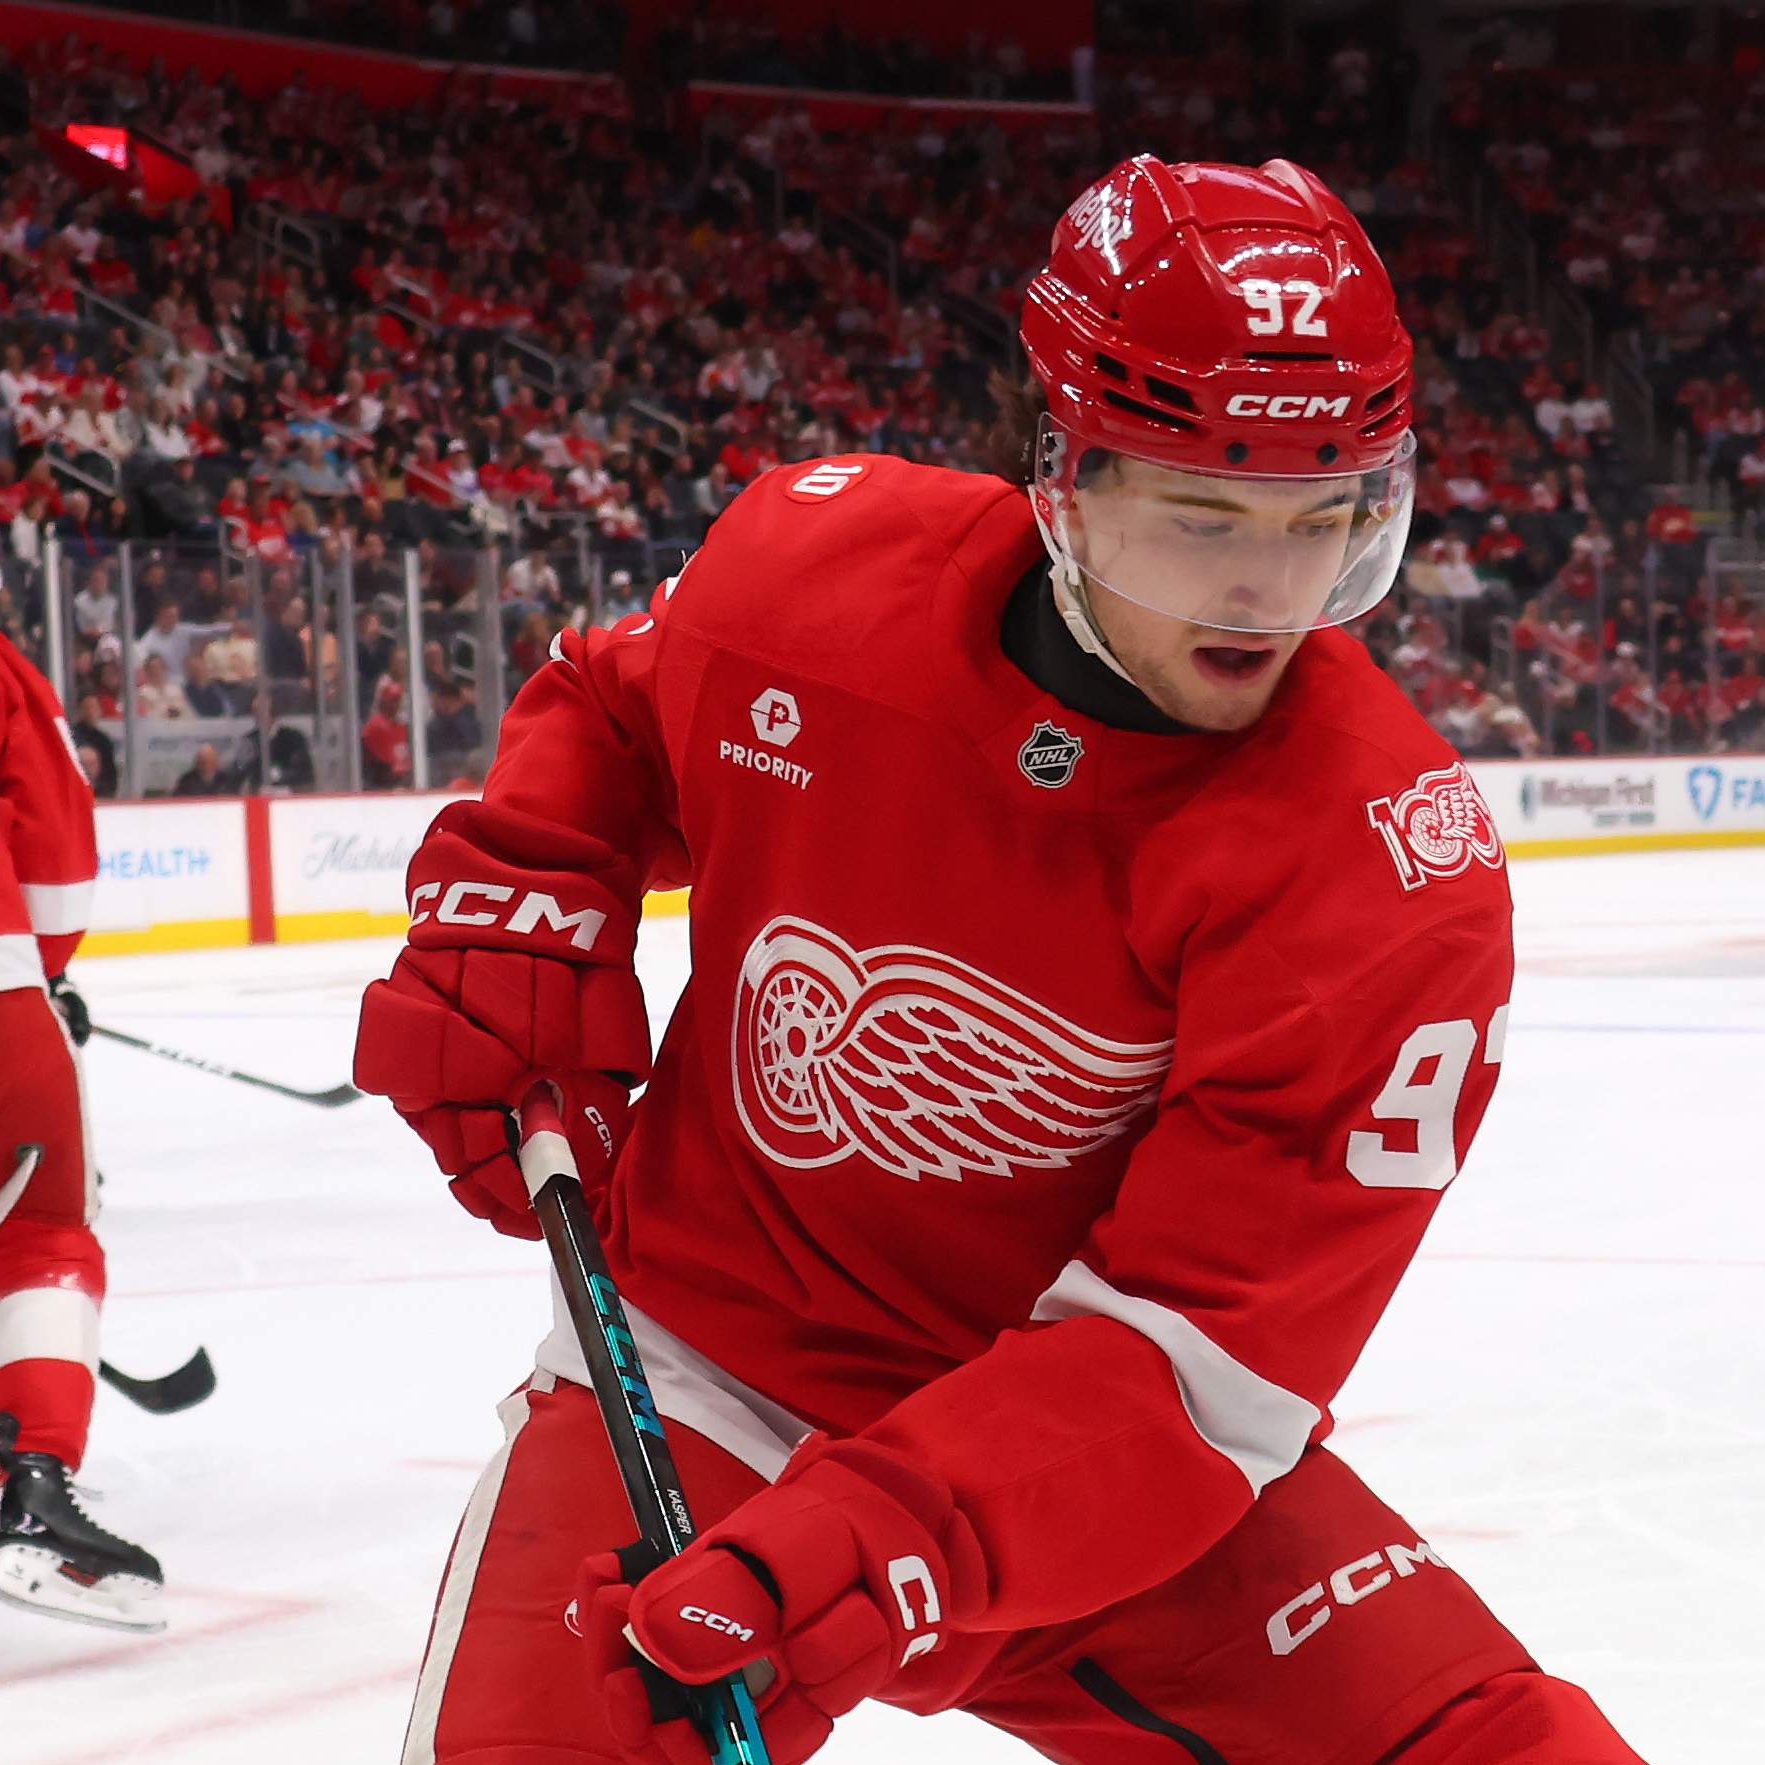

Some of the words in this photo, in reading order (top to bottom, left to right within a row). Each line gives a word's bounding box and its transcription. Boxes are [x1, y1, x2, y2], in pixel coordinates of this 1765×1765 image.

[1239, 278, 1328, 337] 92
[1225, 394, 1351, 419] CCM
[720, 739, 813, 790] PRIORITY
[1028, 748, 1069, 766] NHL
[410, 881, 607, 951] CCM
[667, 1488, 692, 1536] KASPER
[1266, 1542, 1450, 1655] CCM
[679, 1605, 755, 1642] CCM
